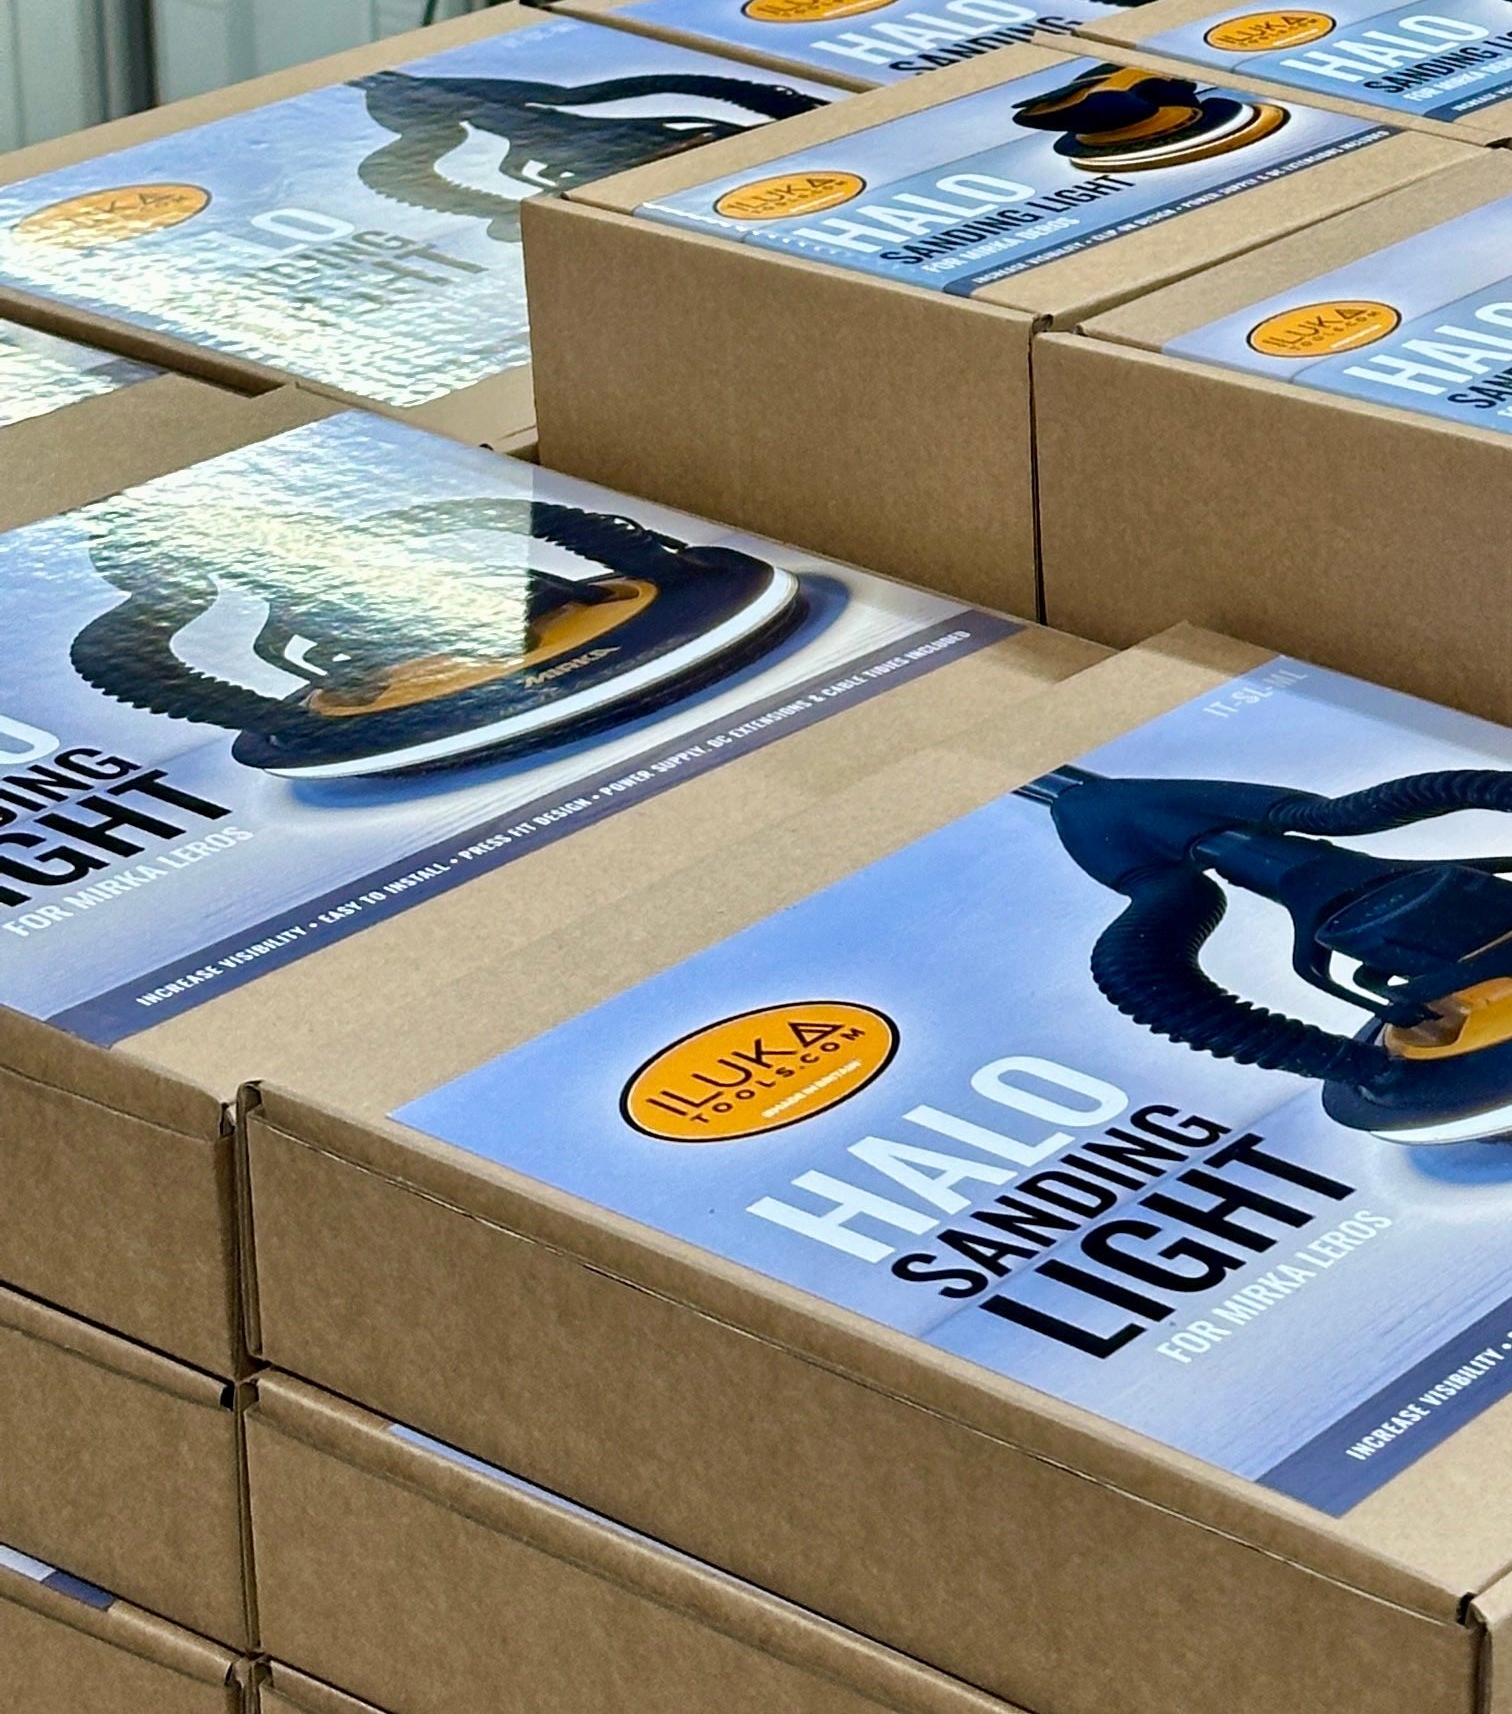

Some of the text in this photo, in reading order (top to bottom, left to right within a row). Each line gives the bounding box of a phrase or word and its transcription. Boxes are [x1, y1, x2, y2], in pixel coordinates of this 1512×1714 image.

[1280, 15, 1489, 82] HALO
[1363, 41, 1503, 95] SANDING
[727, 177, 837, 215] ILUKA
[794, 173, 1037, 253] HALO
[879, 175, 1136, 266] SANDING LIGHT
[921, 257, 963, 274] FOR
[1262, 308, 1368, 349] ILUKA
[525, 646, 622, 689] MIRKA
[0, 769, 232, 907] GHT
[3, 826, 253, 937] FOR MIRKA LEROS
[135, 966, 223, 1007] INCREASE
[218, 925, 307, 969] VISIBILITY
[318, 901, 362, 924] EASY
[361, 891, 386, 905] TO
[383, 862, 450, 894] INSTALL
[458, 833, 512, 861] PRESS
[508, 822, 536, 839] FIT
[532, 797, 592, 825] DESIGN
[599, 770, 654, 796] POWER
[728, 700, 812, 739] EXTENSIONS
[821, 676, 869, 698] CABLE
[646, 1022, 844, 1116] ILUKA
[690, 1027, 865, 1123] TOOLS.COM
[746, 1055, 1128, 1264] HALO
[891, 1105, 1232, 1298] SANDING
[980, 1133, 1356, 1359] LIGHT
[1156, 1210, 1392, 1364] FOR MIRKA LEROS
[1346, 1403, 1431, 1460] INCREASE
[1419, 1348, 1504, 1407] VISIBILITY
